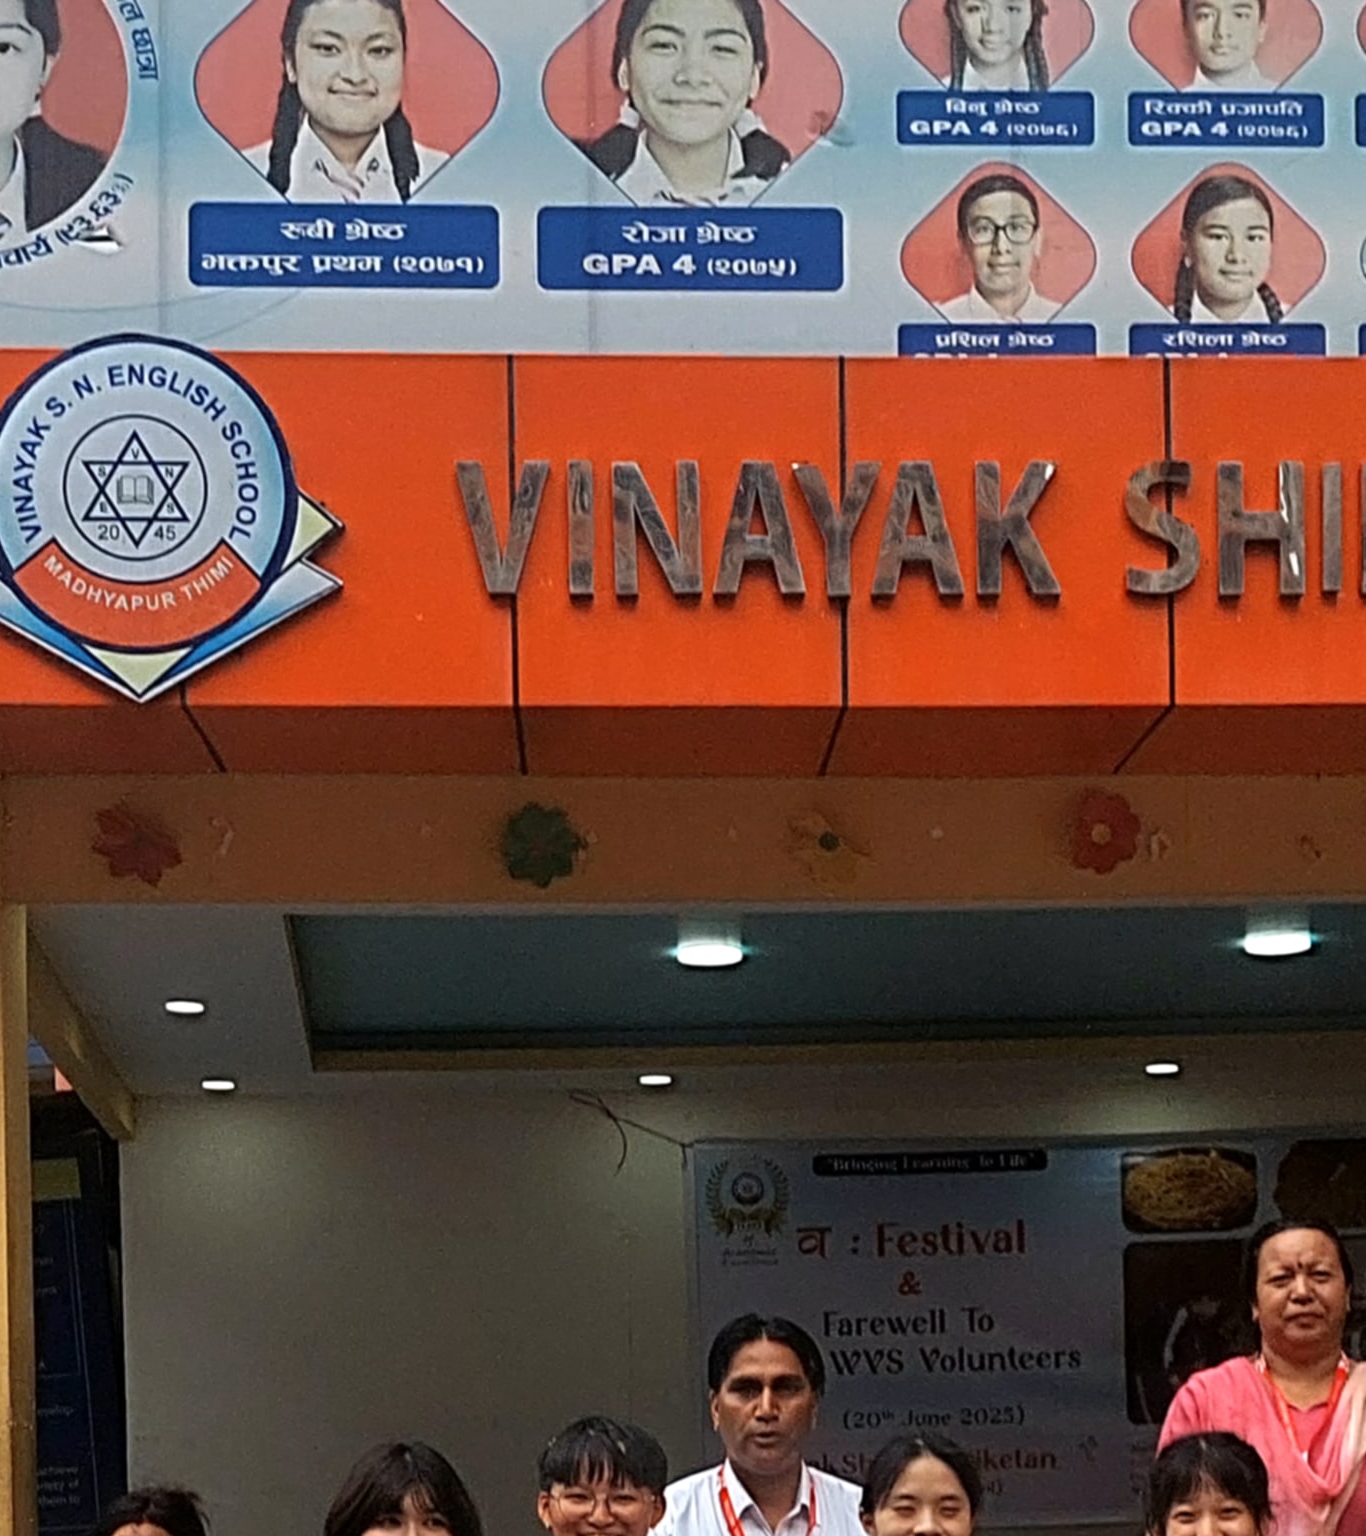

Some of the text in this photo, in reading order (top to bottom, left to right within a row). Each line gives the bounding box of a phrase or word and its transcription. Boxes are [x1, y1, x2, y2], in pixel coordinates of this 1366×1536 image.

[909, 121, 971, 136] GPA
[979, 121, 999, 136] 4
[1141, 122, 1204, 137] GPA
[1210, 122, 1230, 137] 4
[622, 221, 685, 244] रोजा
[201, 253, 484, 275] भक्तपुर प्रथम (२०७१)
[583, 254, 662, 275] GPA
[672, 254, 696, 275] 4
[12, 364, 260, 546] VINAYAK S. N. ENGLISH SCHOOL
[97, 524, 176, 542] 20 45
[451, 460, 1063, 605] VINAYAK
[43, 554, 235, 611] MADHYAPUR THIMI
[876, 1219, 1026, 1259] Festival
[897, 1270, 922, 1296] &
[822, 1307, 995, 1338] Farewell To
[920, 1345, 1082, 1374] Volunteers
